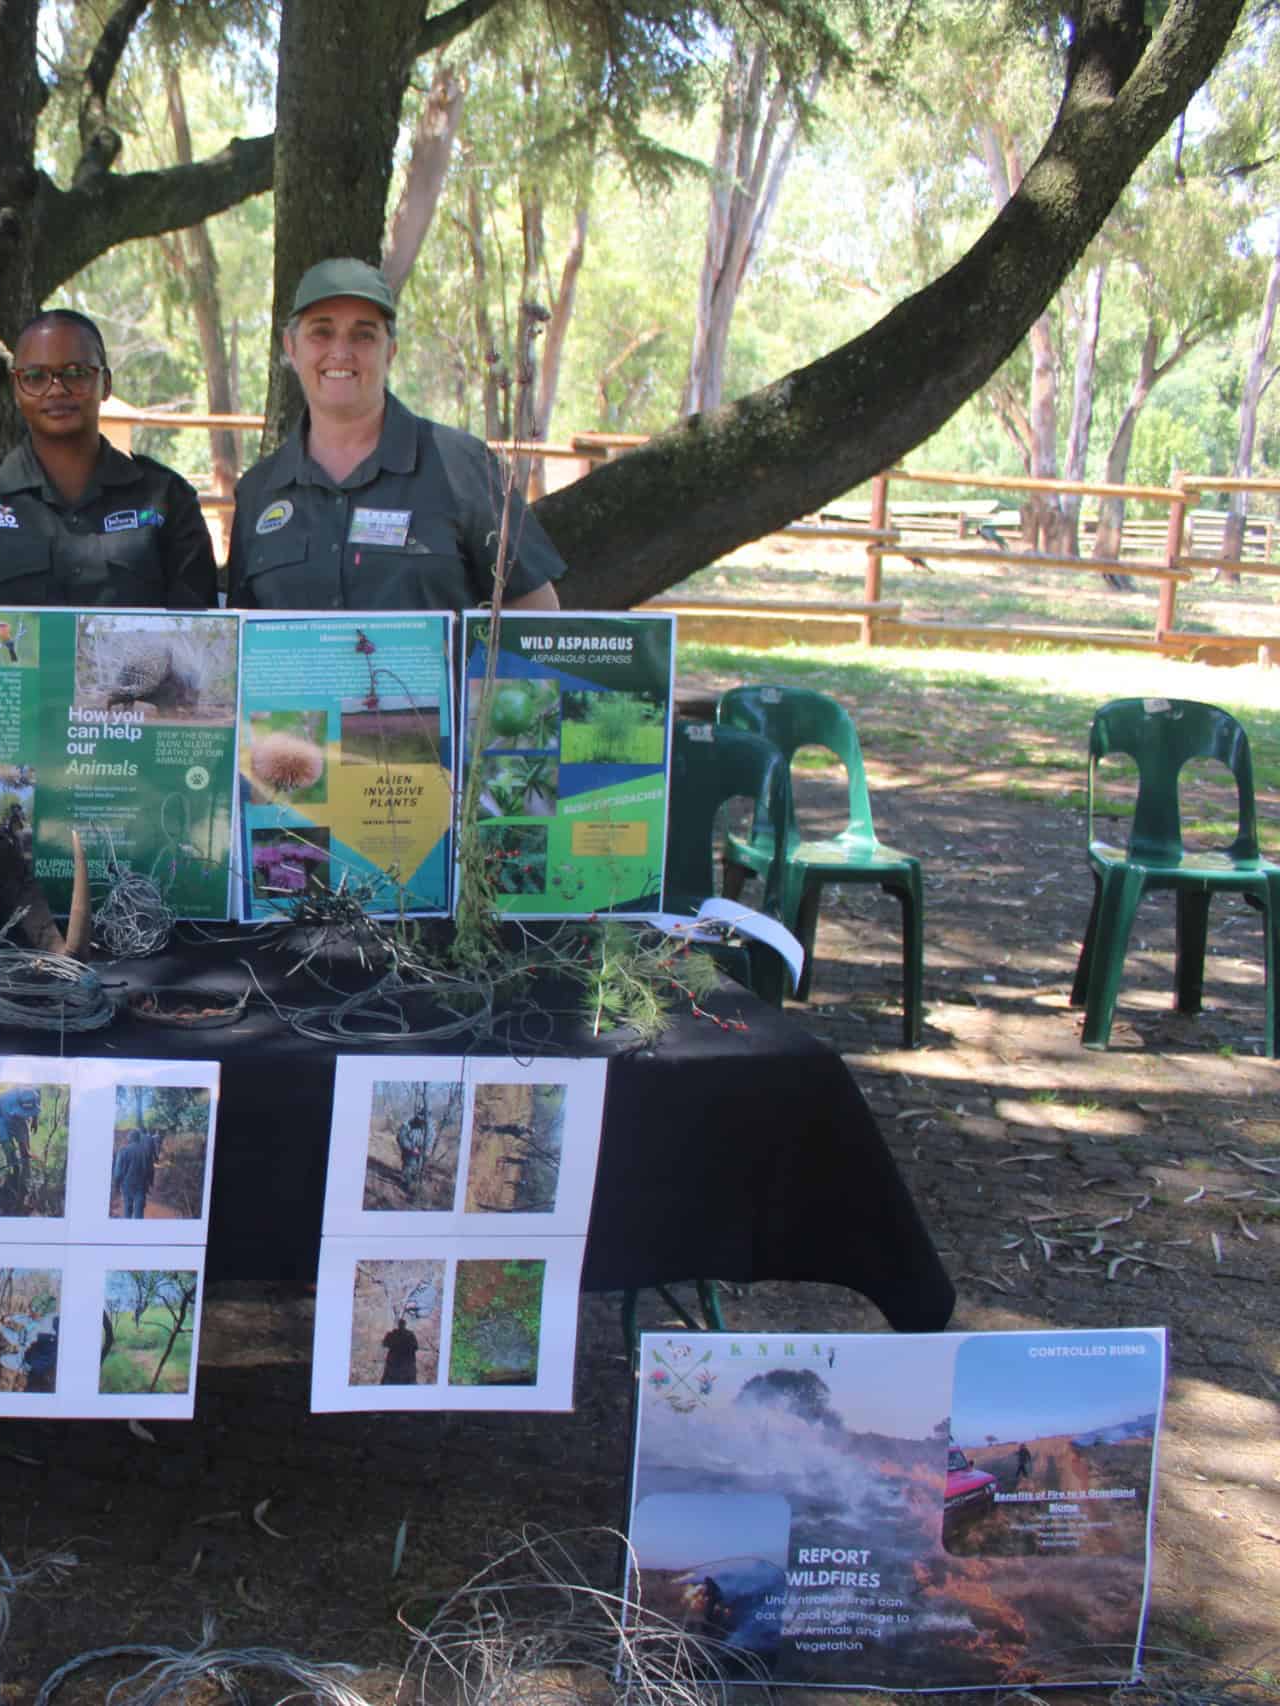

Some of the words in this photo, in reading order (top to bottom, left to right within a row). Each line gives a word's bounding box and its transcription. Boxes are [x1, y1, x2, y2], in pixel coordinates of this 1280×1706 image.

[520, 636, 553, 650] WILD
[557, 636, 634, 650] ASPARAGUS
[529, 654, 586, 664] ASPARAGUS
[588, 654, 633, 664] CAPENSIS
[68, 705, 109, 723] How
[112, 709, 145, 726] you
[67, 726, 99, 740] can
[102, 722, 143, 743] help
[66, 740, 97, 755] our
[64, 759, 139, 777] Animals
[376, 775, 413, 784] ALIEN
[363, 786, 424, 797] INVASIVE
[369, 798, 418, 808] PLANTS
[1029, 1346, 1107, 1358] CONTROLLED
[994, 1491, 1034, 1502] Benefits
[1035, 1491, 1045, 1501] of
[1047, 1490, 1065, 1500] Fire
[798, 1548, 872, 1565] REPORT
[784, 1570, 881, 1588] WILDFIRES
[878, 1598, 903, 1607] can
[897, 1612, 910, 1623] to
[805, 1624, 852, 1636] Animals
[855, 1625, 881, 1638] and
[794, 1640, 864, 1652] Vegetation
